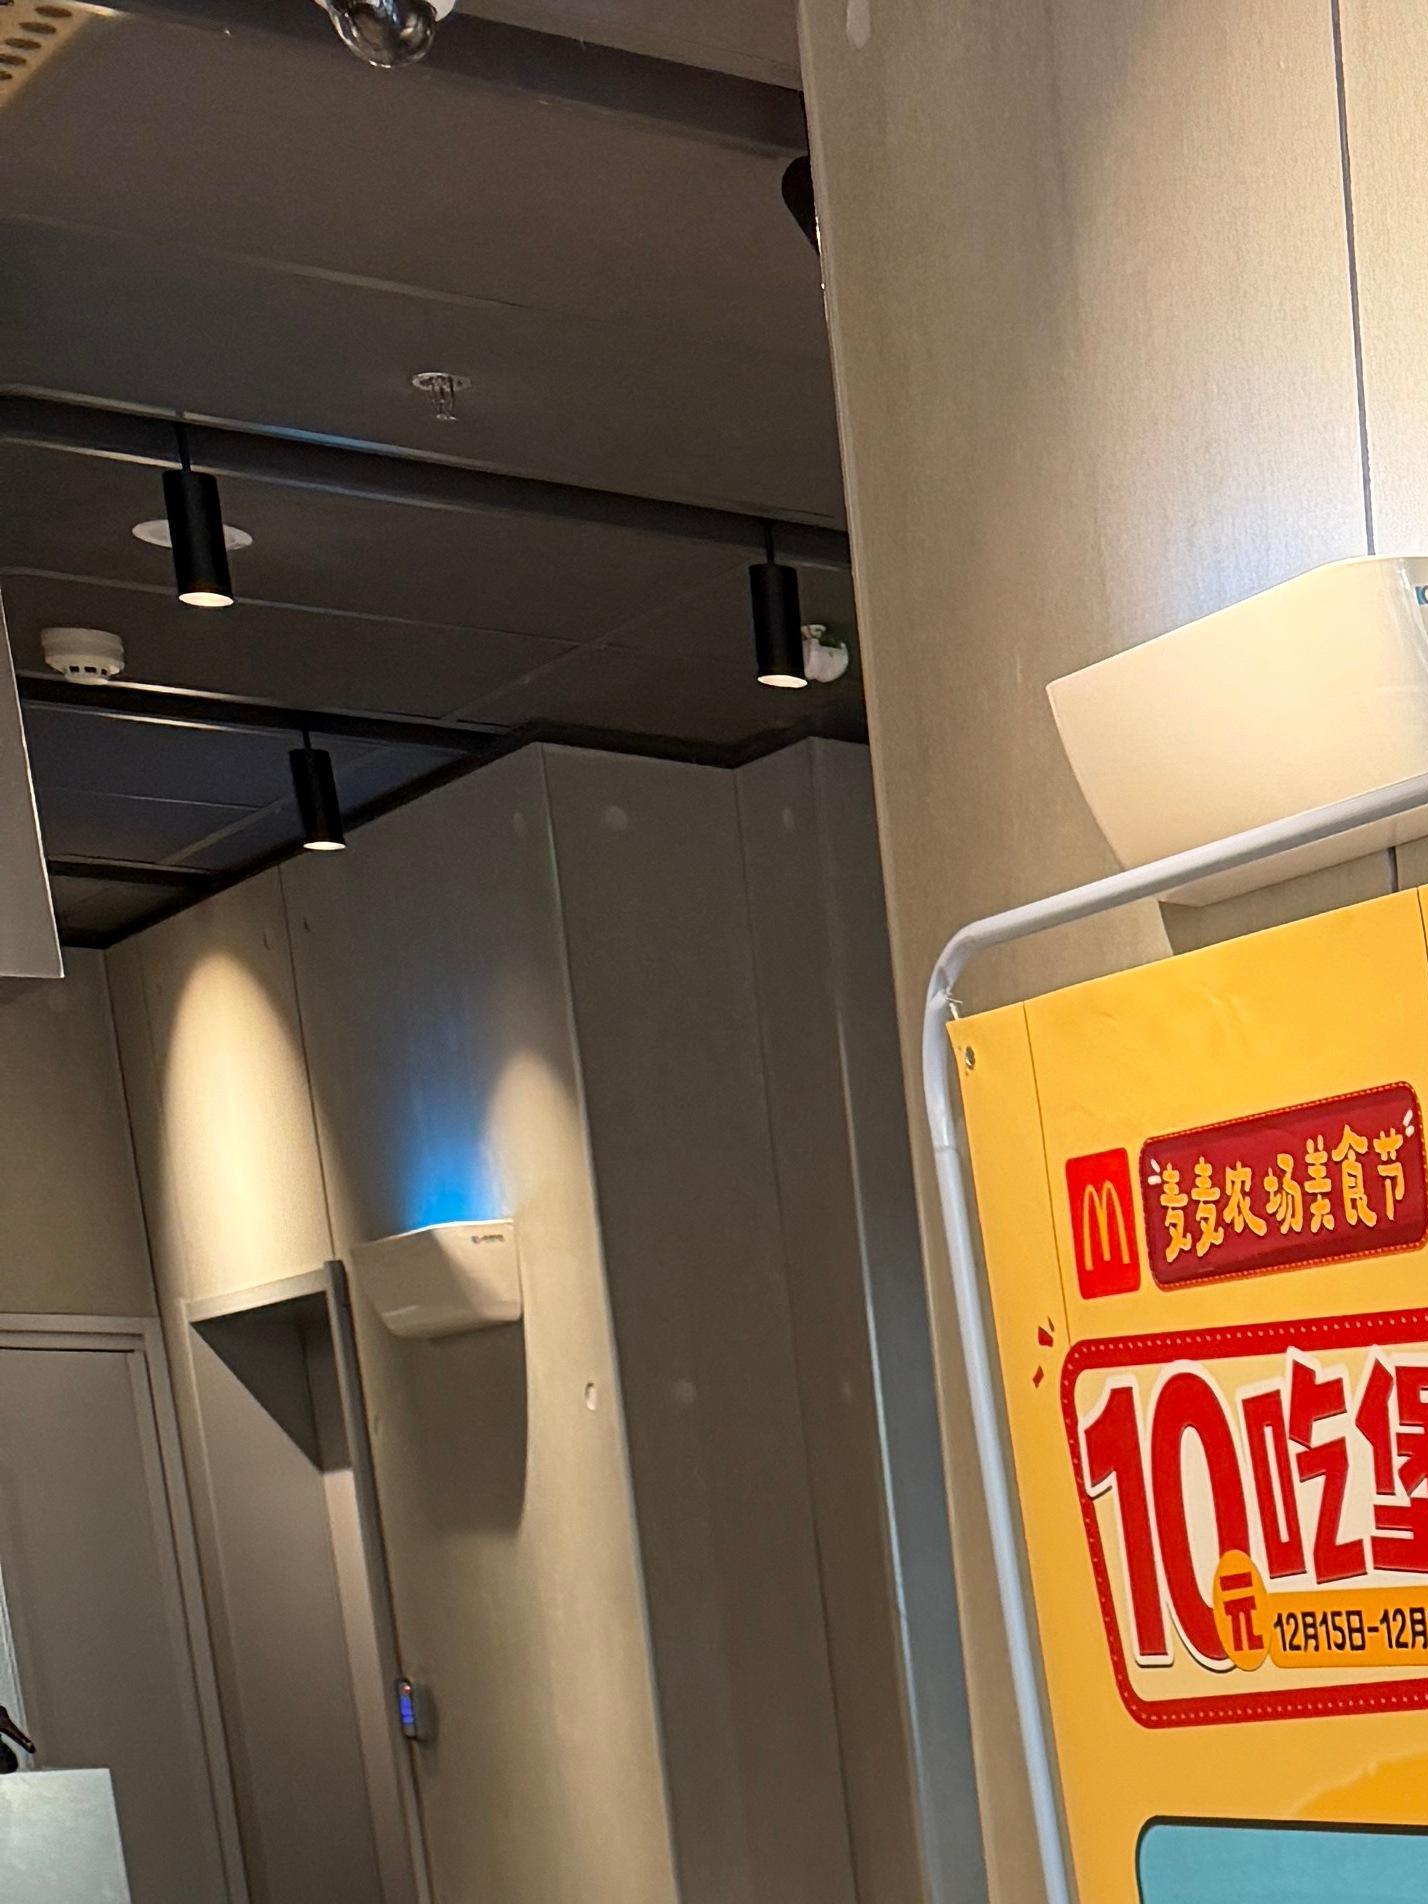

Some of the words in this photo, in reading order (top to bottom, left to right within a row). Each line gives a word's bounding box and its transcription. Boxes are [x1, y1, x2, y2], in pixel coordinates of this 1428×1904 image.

[1160, 1124, 1405, 1263] 麦麦农场美食节
